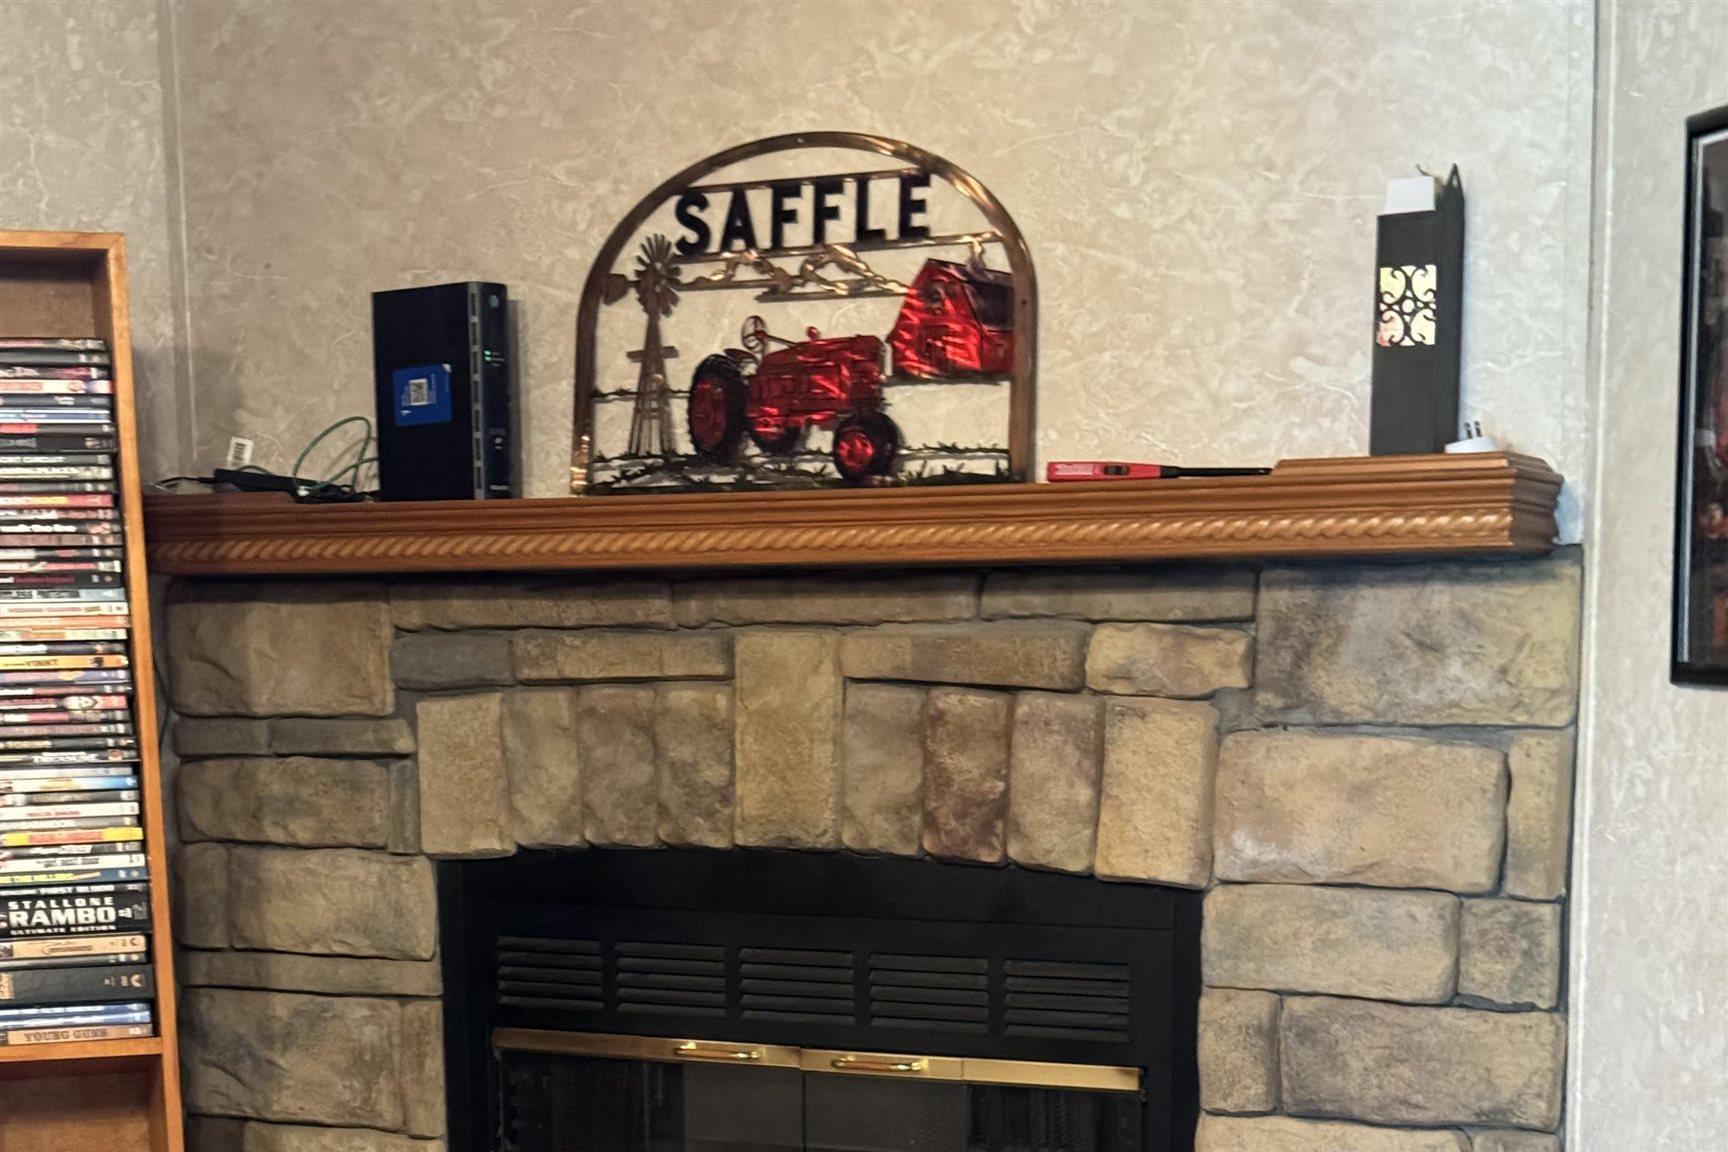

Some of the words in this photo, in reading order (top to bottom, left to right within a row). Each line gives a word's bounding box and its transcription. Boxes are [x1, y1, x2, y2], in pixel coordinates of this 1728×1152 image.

[674, 174, 931, 257] SAFFLE
[8, 897, 114, 910] STALLONE
[8, 907, 116, 927] RAMBO
[24, 1029, 70, 1043] YOUNG
[73, 1027, 108, 1040] GUNS
